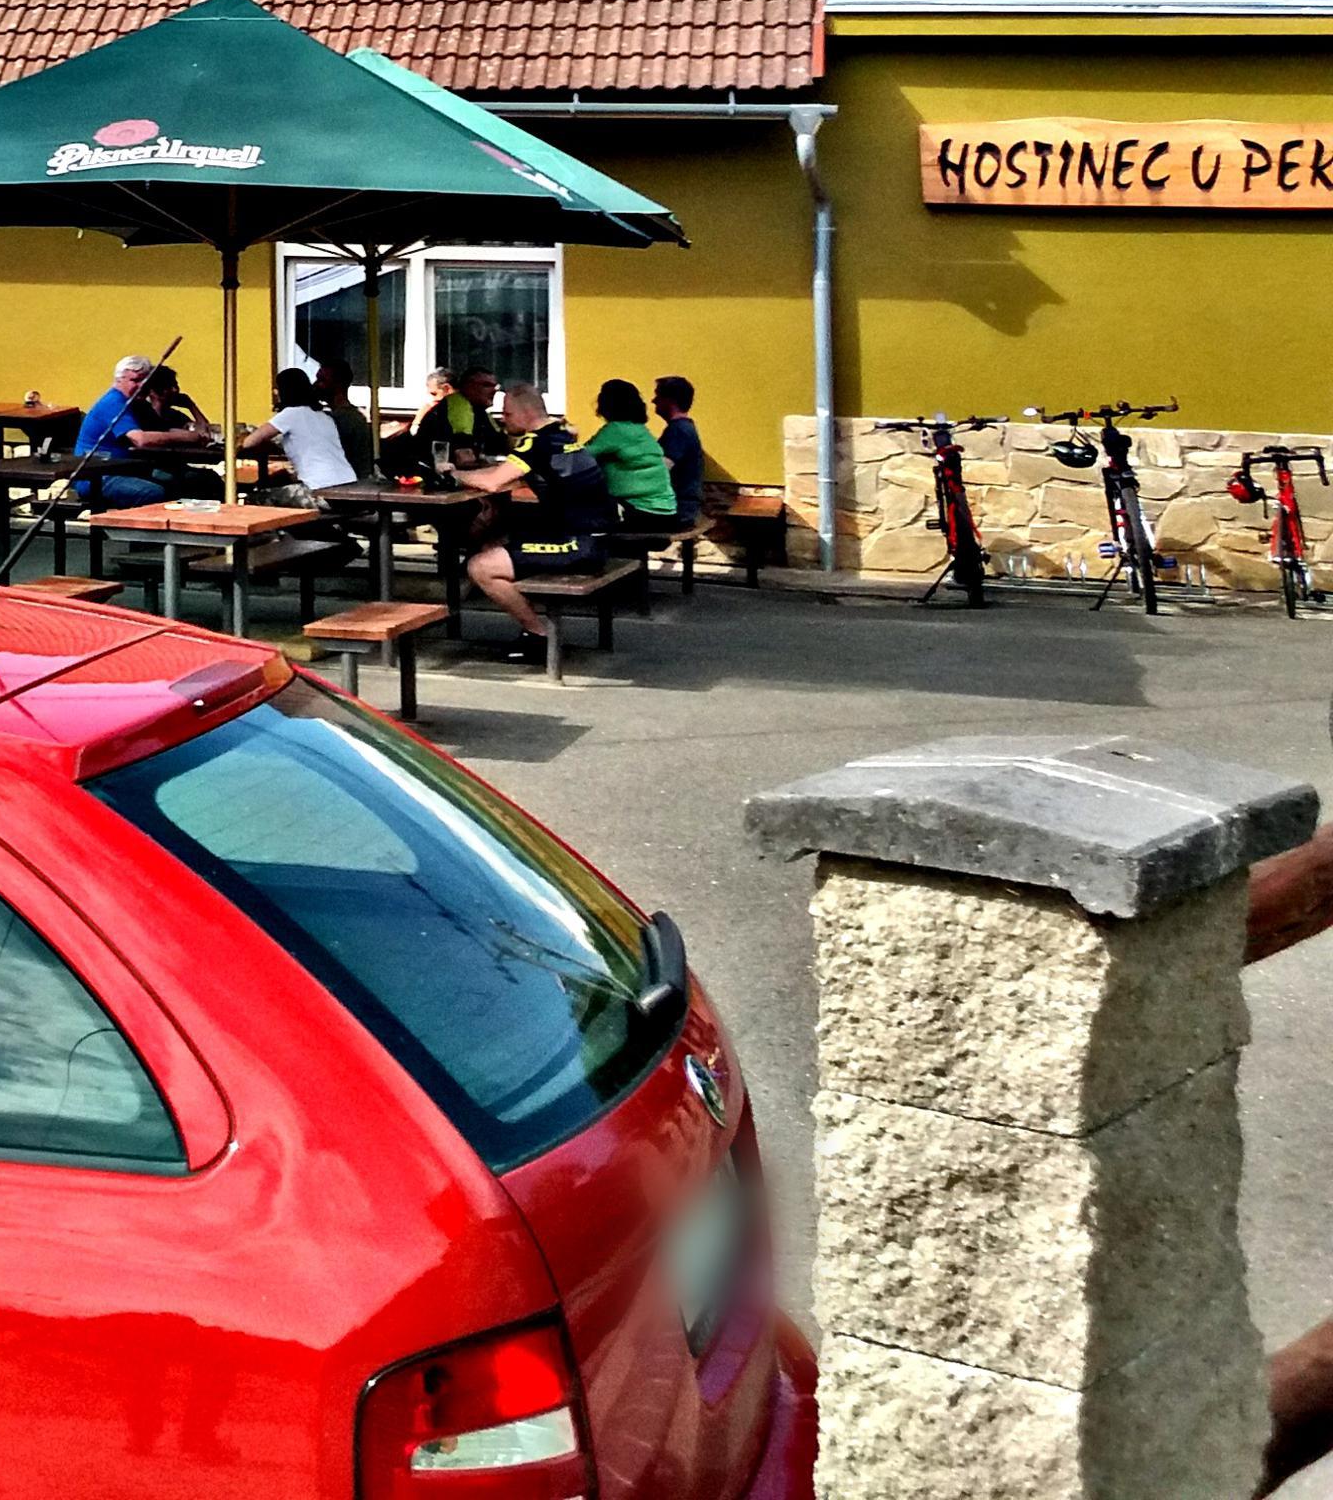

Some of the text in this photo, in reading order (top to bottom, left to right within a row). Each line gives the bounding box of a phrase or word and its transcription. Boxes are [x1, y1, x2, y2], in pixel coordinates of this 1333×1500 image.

[46, 136, 263, 176] Pilsner Urquell
[937, 138, 1171, 195] HOSTINEC
[1191, 144, 1221, 193] U
